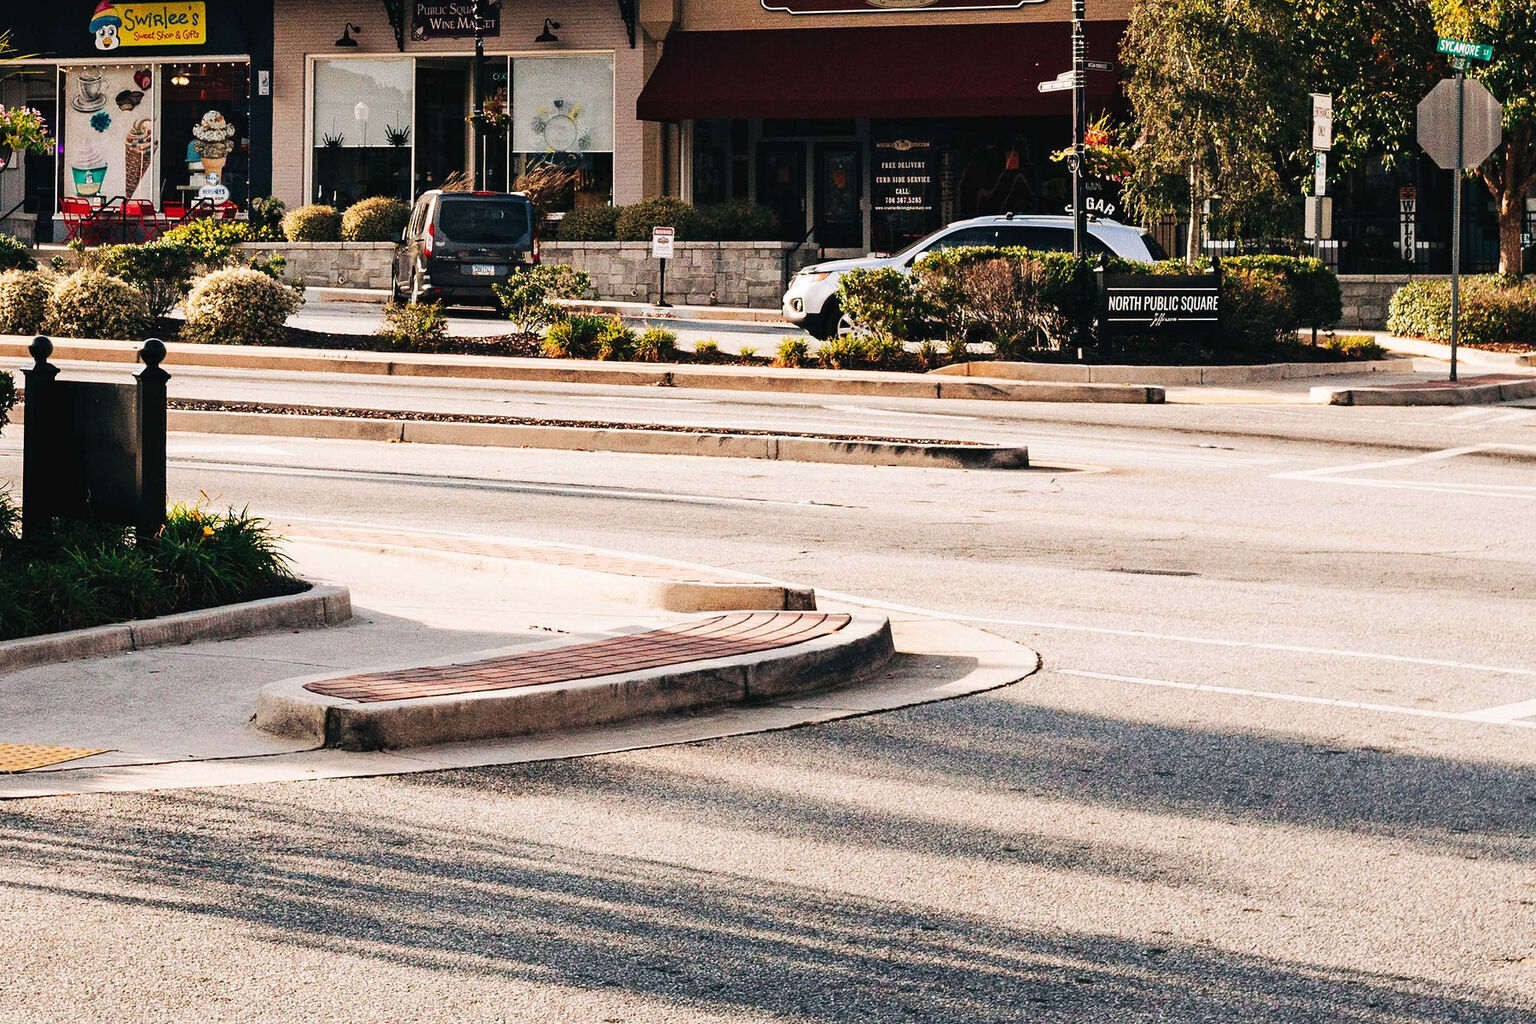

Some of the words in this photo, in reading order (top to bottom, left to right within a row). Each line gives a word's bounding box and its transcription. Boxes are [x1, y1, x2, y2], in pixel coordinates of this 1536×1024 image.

[449, 2, 475, 16] SQUA
[124, 6, 200, 32] Swirlee's
[457, 17, 496, 30] MAET
[133, 31, 155, 42] Sweet
[156, 31, 174, 41] Shop
[175, 31, 182, 40] &
[1439, 39, 1481, 57] SYCAMORE
[897, 161, 926, 169] DELIVERY
[906, 176, 931, 184] SERVICE
[1064, 197, 1116, 216] SGAR
[1402, 200, 1415, 261] WELCO
[1108, 296, 1142, 311] NORTH
[1144, 296, 1179, 311] PUBLIC
[1180, 296, 1219, 313] SQUARE
